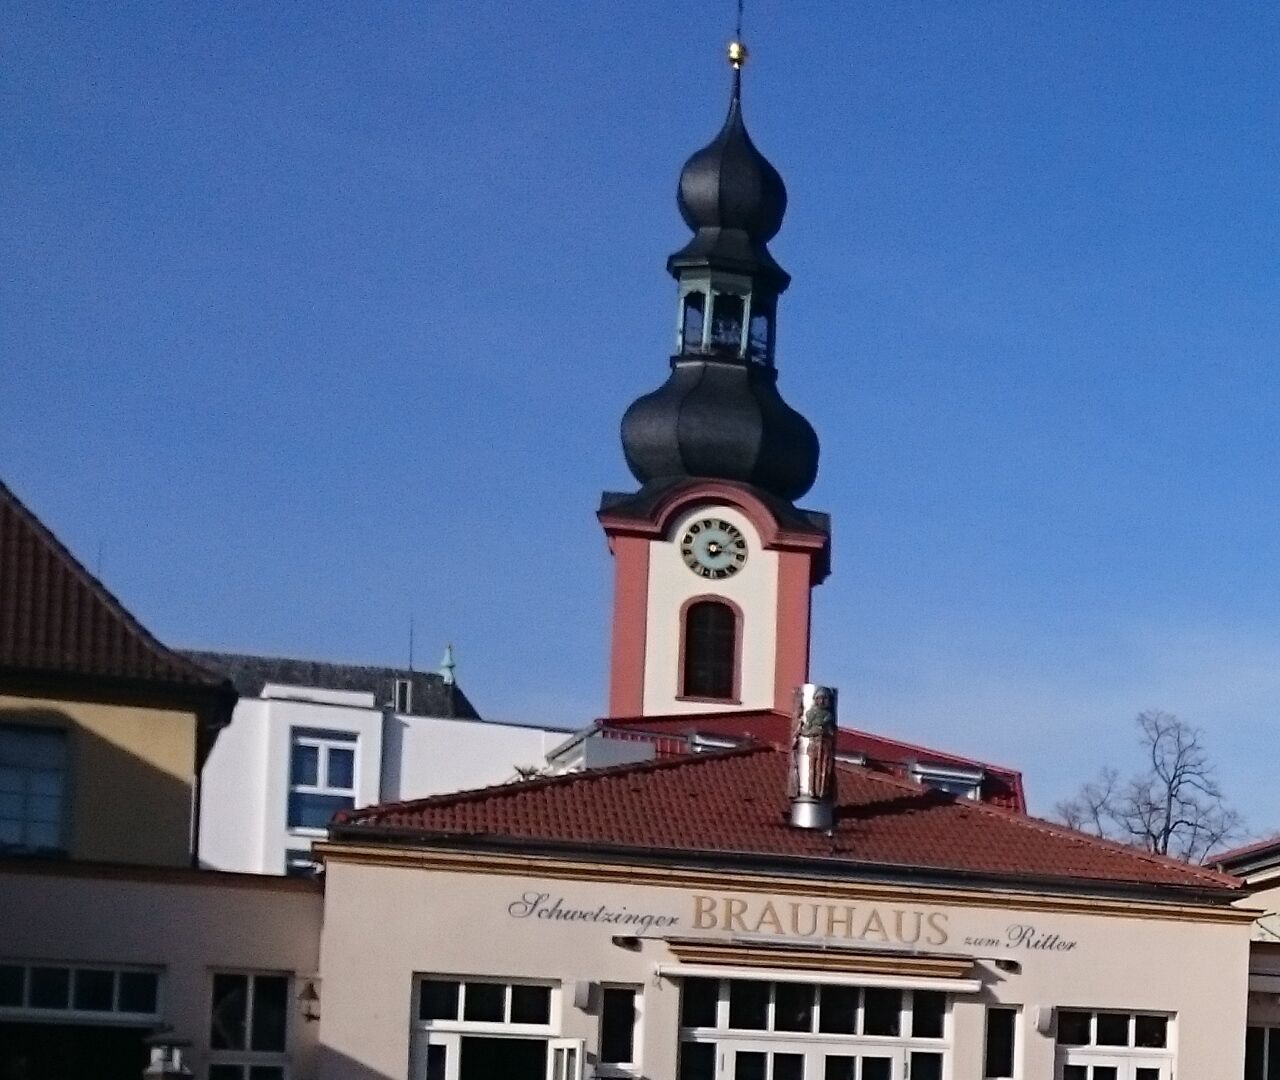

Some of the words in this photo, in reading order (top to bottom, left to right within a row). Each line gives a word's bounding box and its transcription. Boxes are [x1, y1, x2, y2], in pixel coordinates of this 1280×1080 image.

[508, 891, 679, 935] Schwetzinger
[691, 895, 949, 946] BRAUHAUS
[964, 935, 1000, 948] zum
[1005, 923, 1078, 952] Ritter
